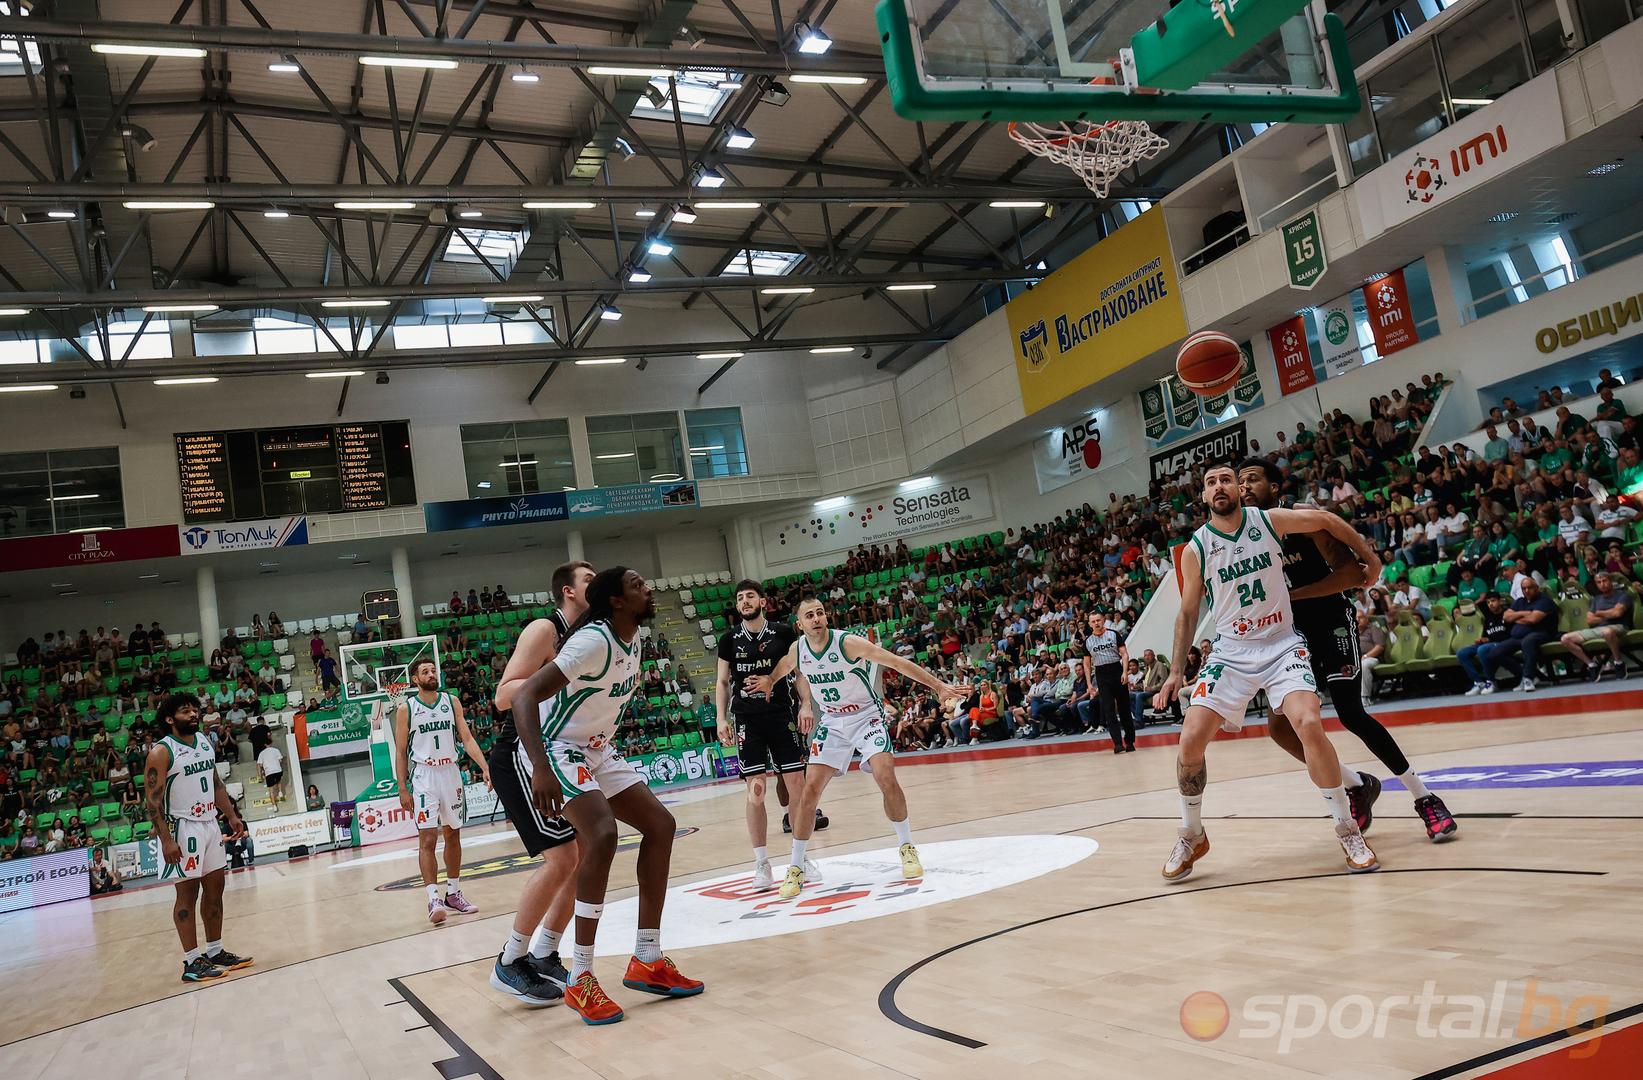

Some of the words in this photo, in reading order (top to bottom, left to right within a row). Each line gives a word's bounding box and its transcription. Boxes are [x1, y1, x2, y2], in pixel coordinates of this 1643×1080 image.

[1287, 218, 1312, 234] ХРИСТОВ
[1293, 235, 1315, 265] 15
[1100, 278, 1132, 301] ДОСТЪПНАТА
[1132, 256, 1161, 282] СИГУРНОСТ
[1296, 266, 1318, 282] БАЛКАН
[1054, 271, 1168, 353] ЗАСТРАХОВАНЕ
[1535, 292, 1643, 354] ОБЩИ
[1384, 334, 1409, 349] PARTNER
[1385, 328, 1405, 343] PROUD
[1288, 376, 1309, 387] PARTNER
[1289, 370, 1306, 380] PROUD
[1062, 418, 1101, 459] APS
[893, 486, 971, 515] Sensata
[481, 510, 515, 522] PHYTO
[519, 506, 563, 519] PHARMA
[896, 506, 960, 527] Technologies
[873, 532, 888, 541] World
[888, 527, 911, 537] Depends
[918, 521, 940, 530] Sensors
[940, 518, 951, 527] and
[68, 552, 88, 561] CITY
[89, 550, 115, 559] PLAZA
[1217, 551, 1273, 584] BALKAN
[1237, 578, 1267, 608] 24
[1092, 643, 1115, 652] efbet
[806, 671, 845, 685] BALKAN
[821, 687, 841, 702] 33
[1192, 681, 1216, 699] A1
[321, 722, 340, 730] ФЕН
[418, 720, 451, 735] BALKAN
[863, 728, 883, 740] efbet
[328, 731, 362, 742] БАЛКАН
[433, 735, 440, 750] 1
[811, 742, 824, 757] A1
[183, 759, 215, 776] BALKAN
[200, 776, 208, 793] 0
[419, 794, 425, 808] 1
[465, 793, 498, 806] ensata
[417, 809, 430, 825] A1
[187, 837, 197, 853] 0
[50, 864, 90, 879] ЕООД
[185, 855, 200, 872] A1
